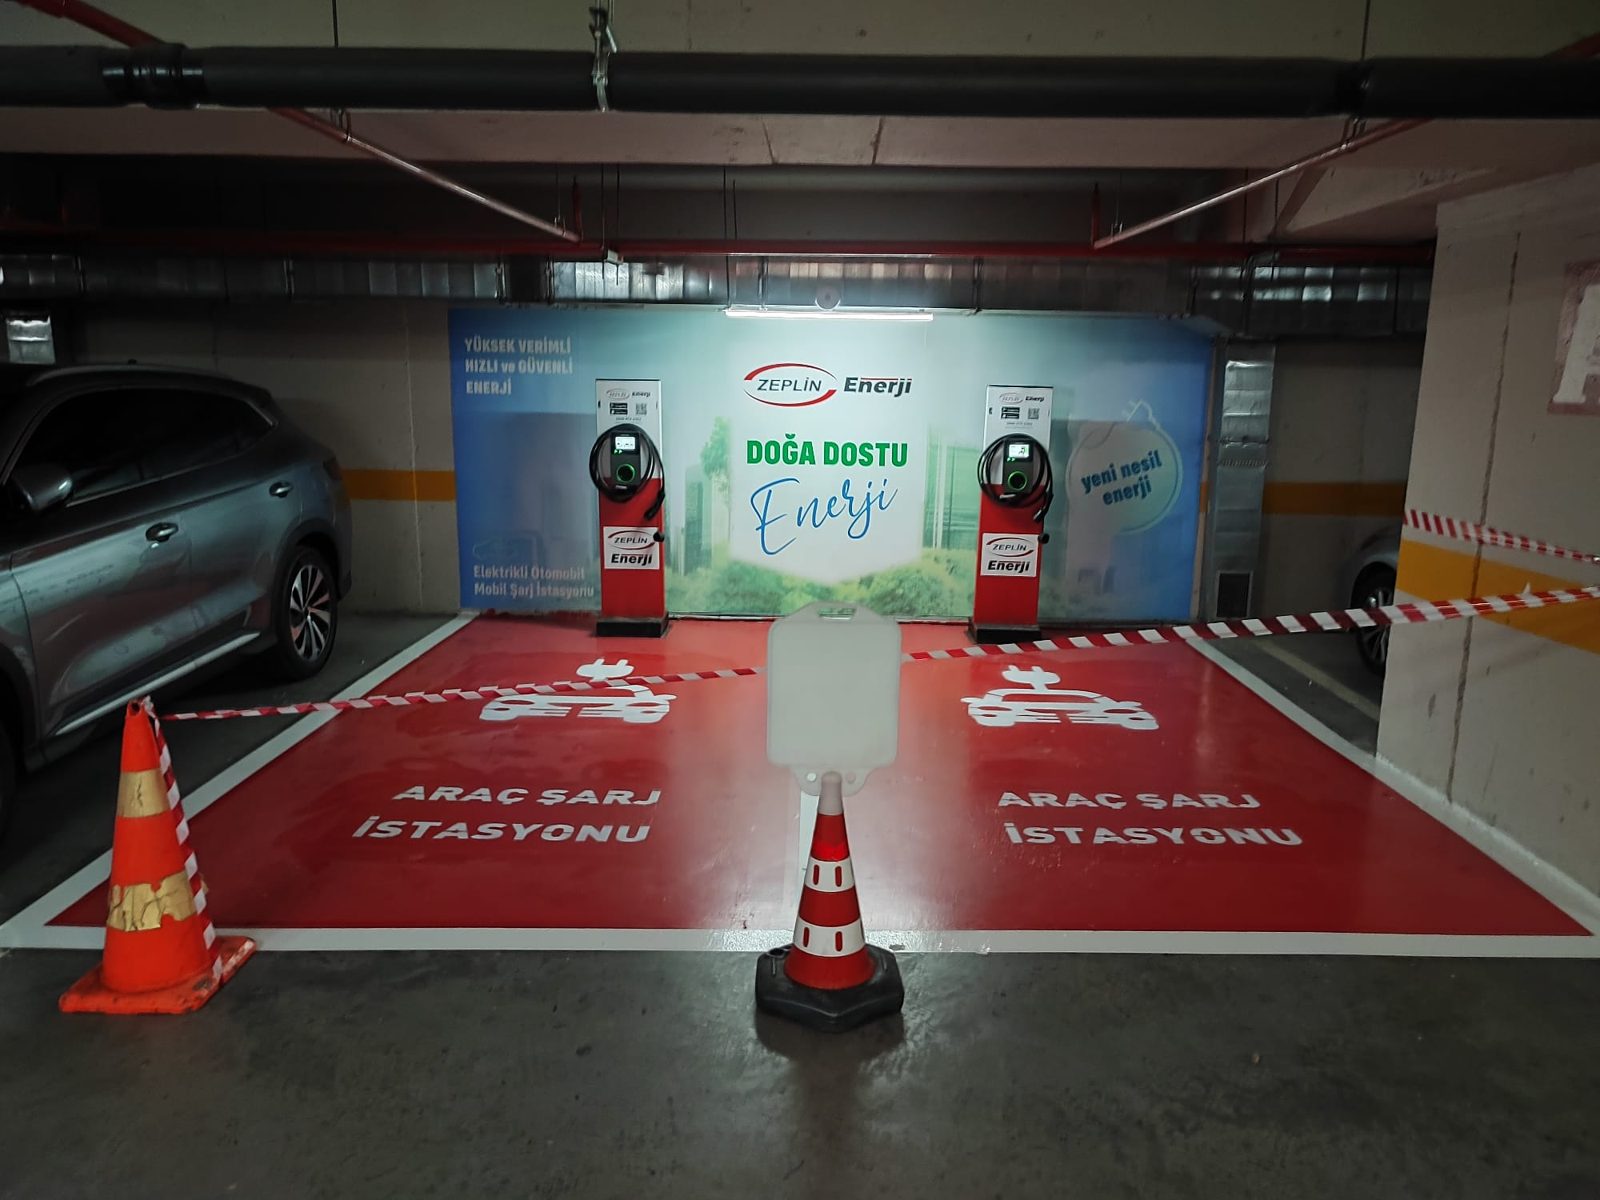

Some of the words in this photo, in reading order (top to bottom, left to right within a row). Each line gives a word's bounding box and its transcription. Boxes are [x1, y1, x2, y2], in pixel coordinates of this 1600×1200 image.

[464, 335, 515, 353] YÜKSEK
[518, 336, 572, 354] VERİMLİ
[465, 358, 499, 373] HIZLI
[501, 361, 516, 373] ve
[518, 356, 573, 375] GÜVENLİ
[466, 377, 513, 395] ENERJİ
[757, 377, 822, 392] ZEPLİN
[843, 377, 912, 397] Enerji
[746, 433, 816, 466] DOĞA
[823, 441, 908, 468] DOSTU
[1080, 462, 1118, 495] yeni
[1120, 449, 1163, 479] nesil
[1102, 474, 1152, 506] enerji
[750, 477, 899, 556] Enerji
[611, 553, 653, 566] Enerji
[987, 560, 1031, 574] Enerji
[473, 564, 529, 579] Elektrikli
[530, 566, 586, 580] Otomobil
[474, 581, 508, 596] Mobil
[509, 582, 535, 599] Şarj
[536, 581, 595, 600] İstasyonu
[392, 785, 529, 805] ARAÇ
[536, 789, 662, 806] ŞARJ
[998, 792, 1128, 810] ARAÇ
[1135, 793, 1261, 810] ŞARJ
[351, 815, 651, 843] İSTASYONU
[1003, 822, 1303, 846] İSTASYONU
